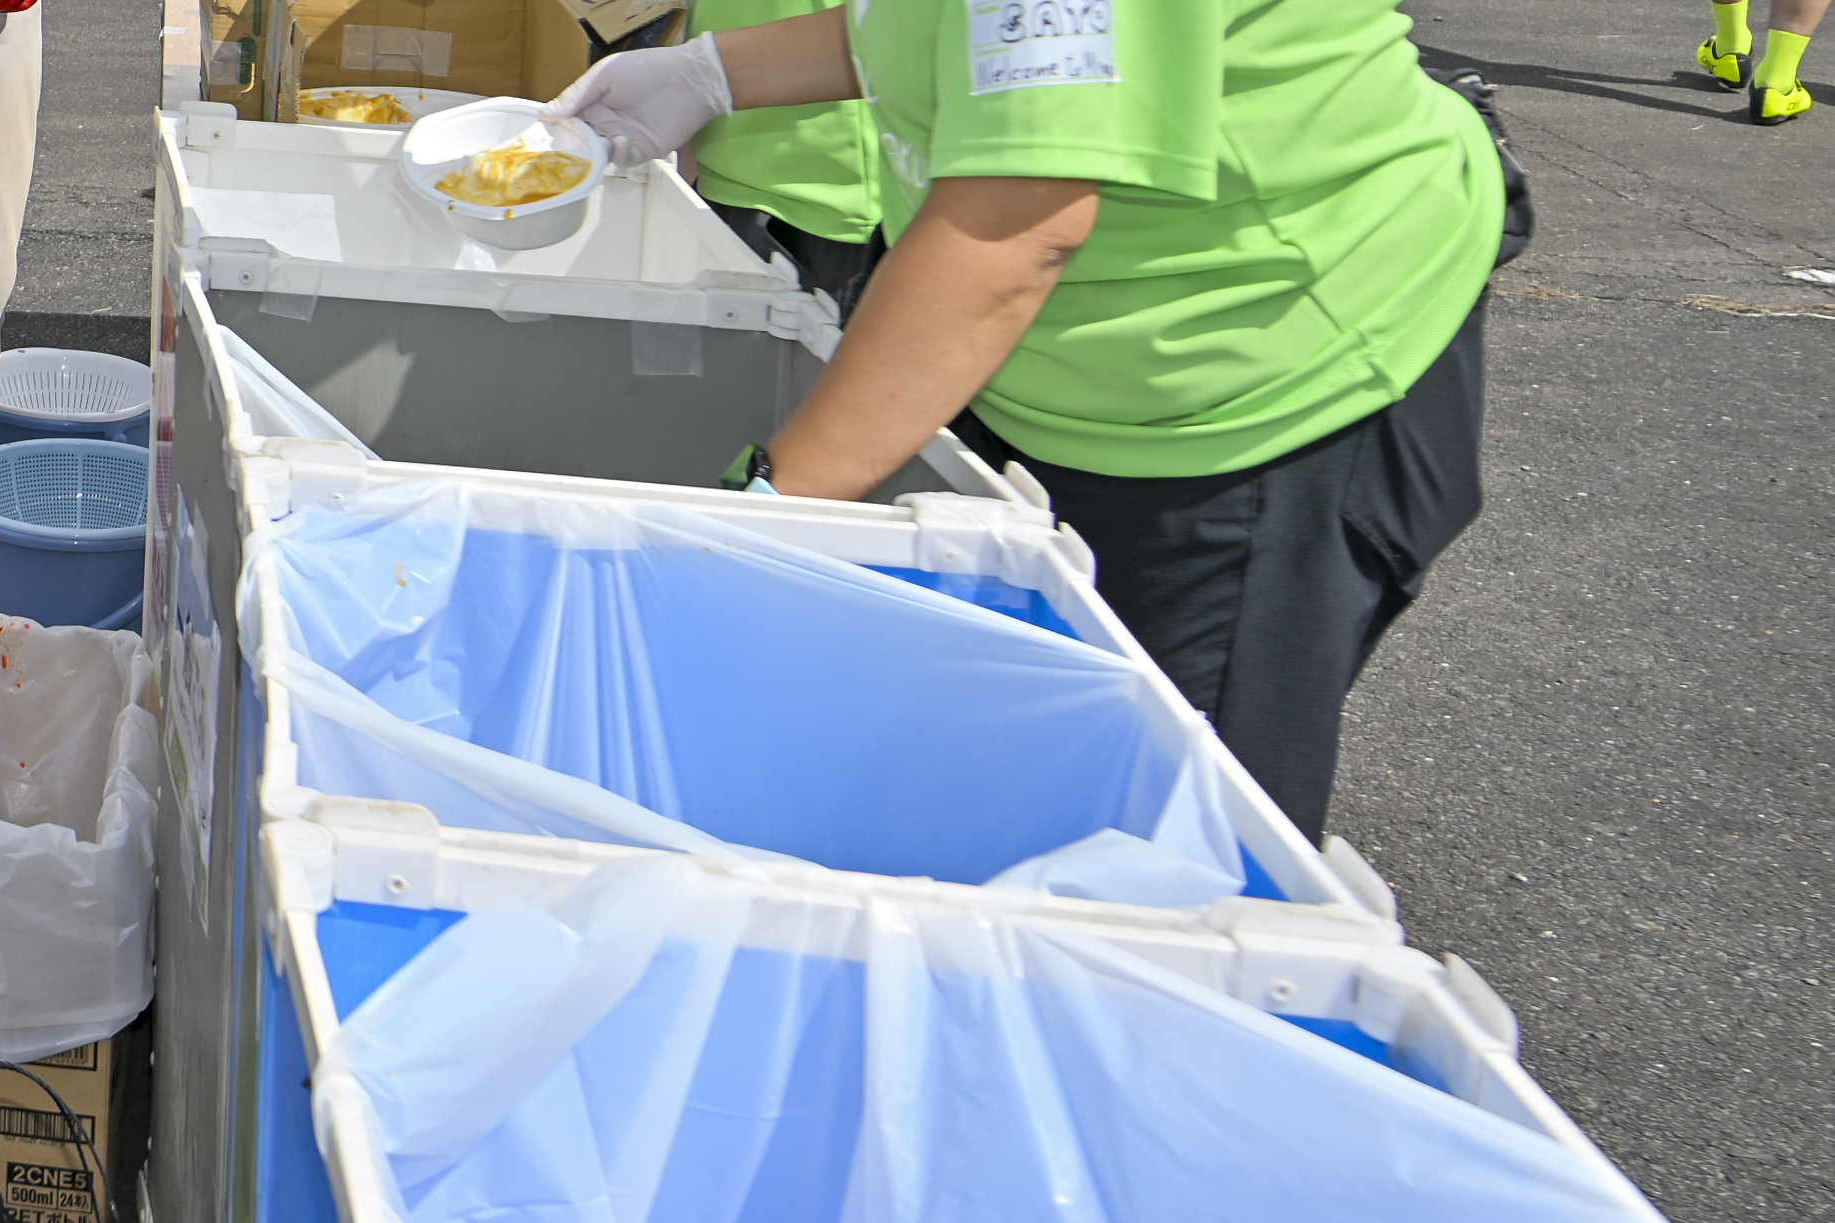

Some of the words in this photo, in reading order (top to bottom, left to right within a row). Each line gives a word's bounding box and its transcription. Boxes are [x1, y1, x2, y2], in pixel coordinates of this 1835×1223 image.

[13, 1165, 87, 1189] 2CNE5
[11, 1186, 53, 1205] 500ml
[60, 1192, 90, 1209] 24本入
